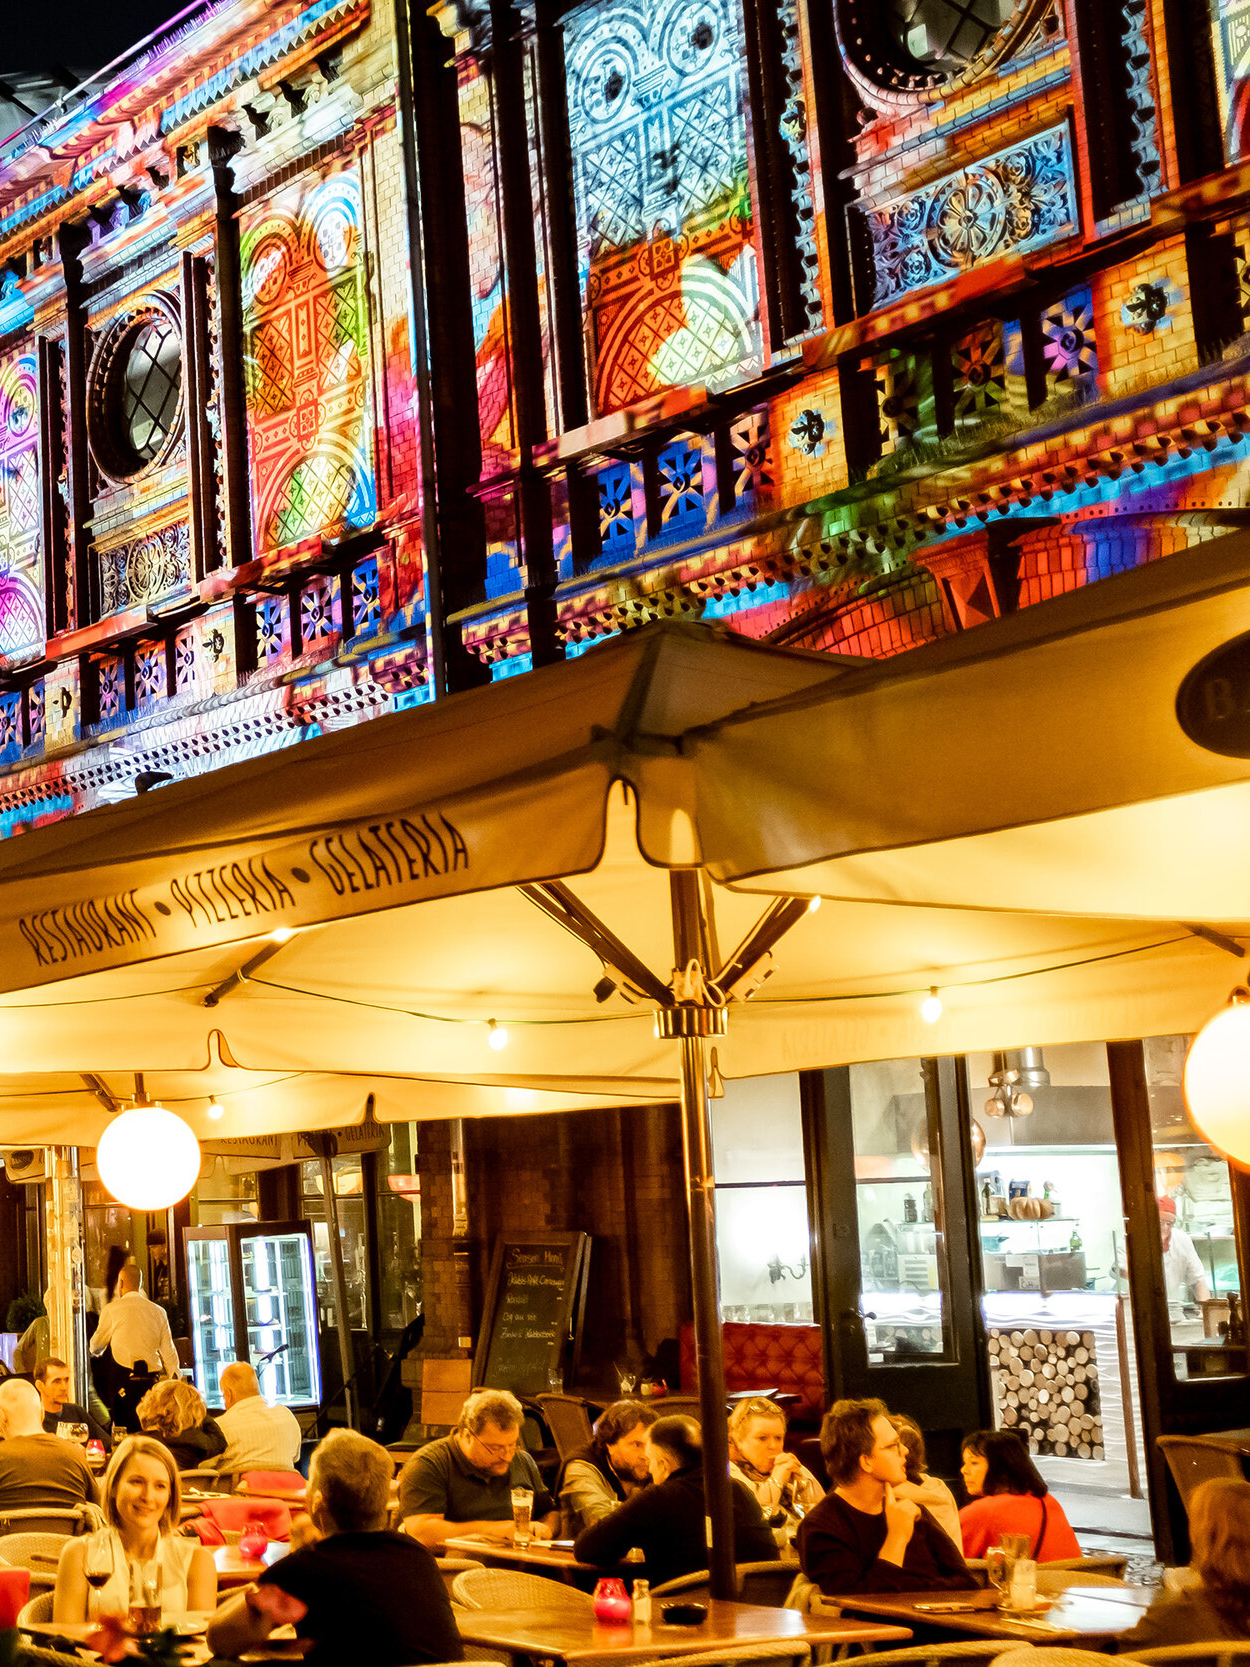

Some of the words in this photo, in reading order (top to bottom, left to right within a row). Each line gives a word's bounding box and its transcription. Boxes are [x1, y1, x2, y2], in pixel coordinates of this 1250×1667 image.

[18, 887, 157, 967] RESTAURANT
[169, 856, 296, 928] PIZZERIA
[309, 811, 469, 896] GELATERIA
